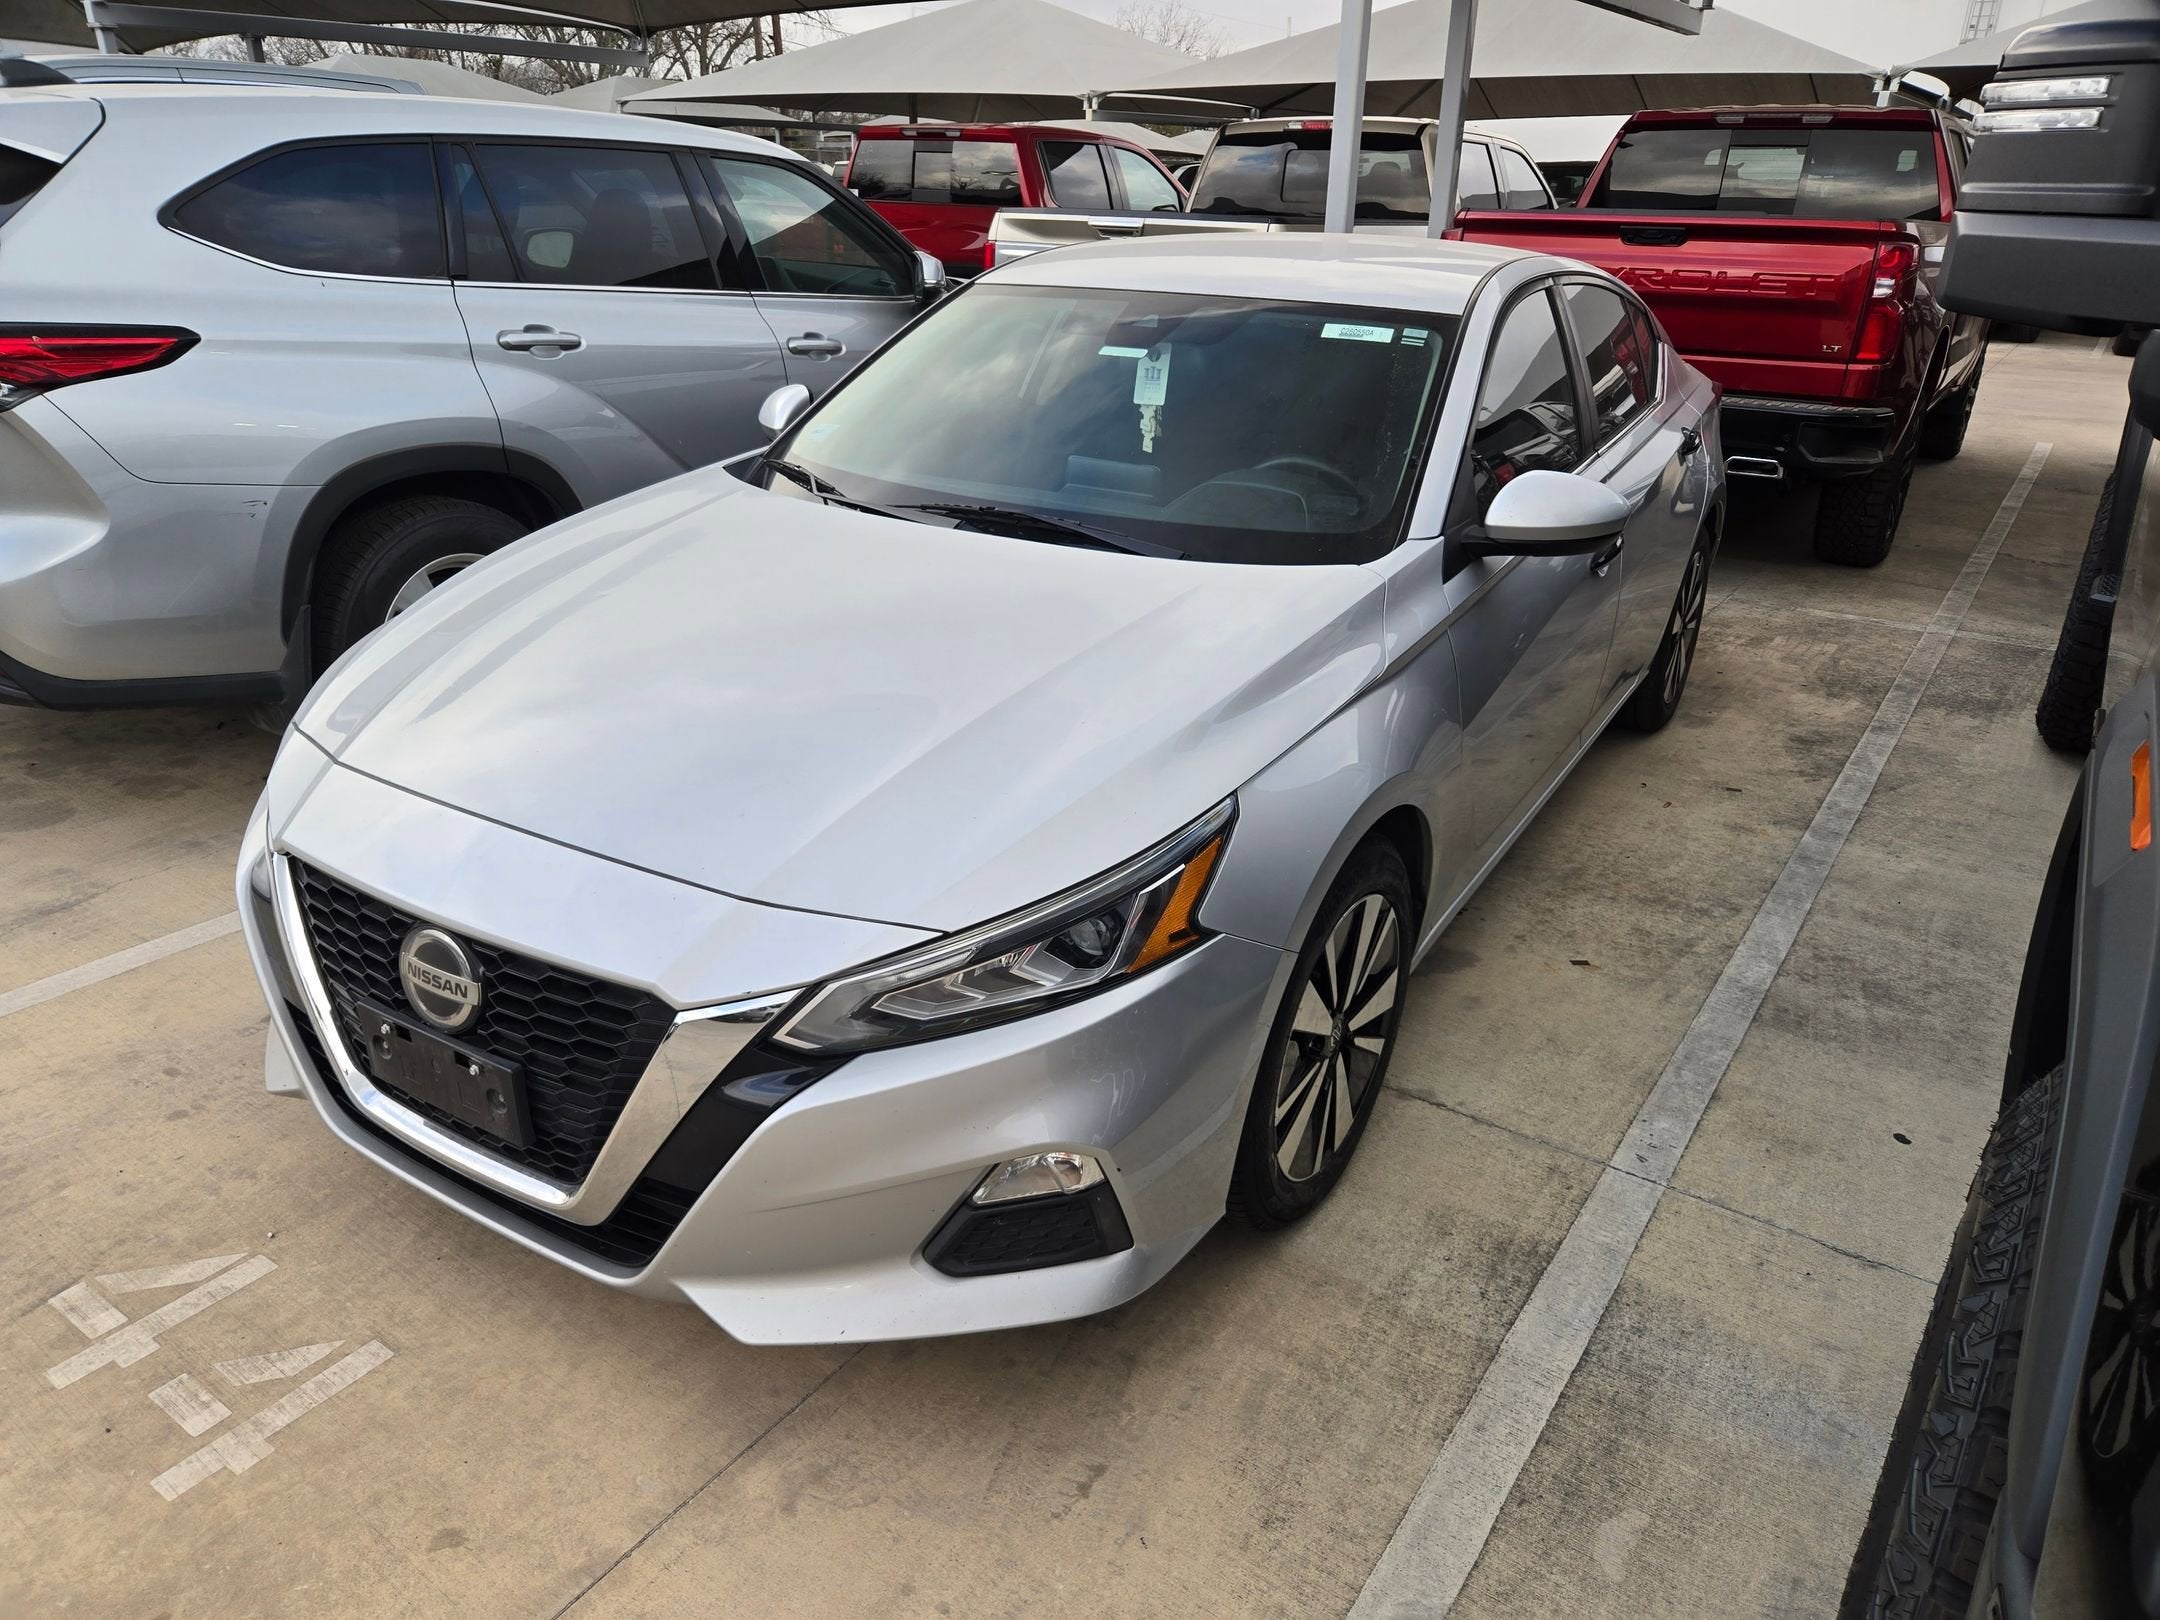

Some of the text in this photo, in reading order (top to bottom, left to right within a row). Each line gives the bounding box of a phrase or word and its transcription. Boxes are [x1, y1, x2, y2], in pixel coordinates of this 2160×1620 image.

[1822, 344, 1842, 353] LT
[407, 962, 468, 999] NISSAN
[47, 1252, 394, 1501] 44
